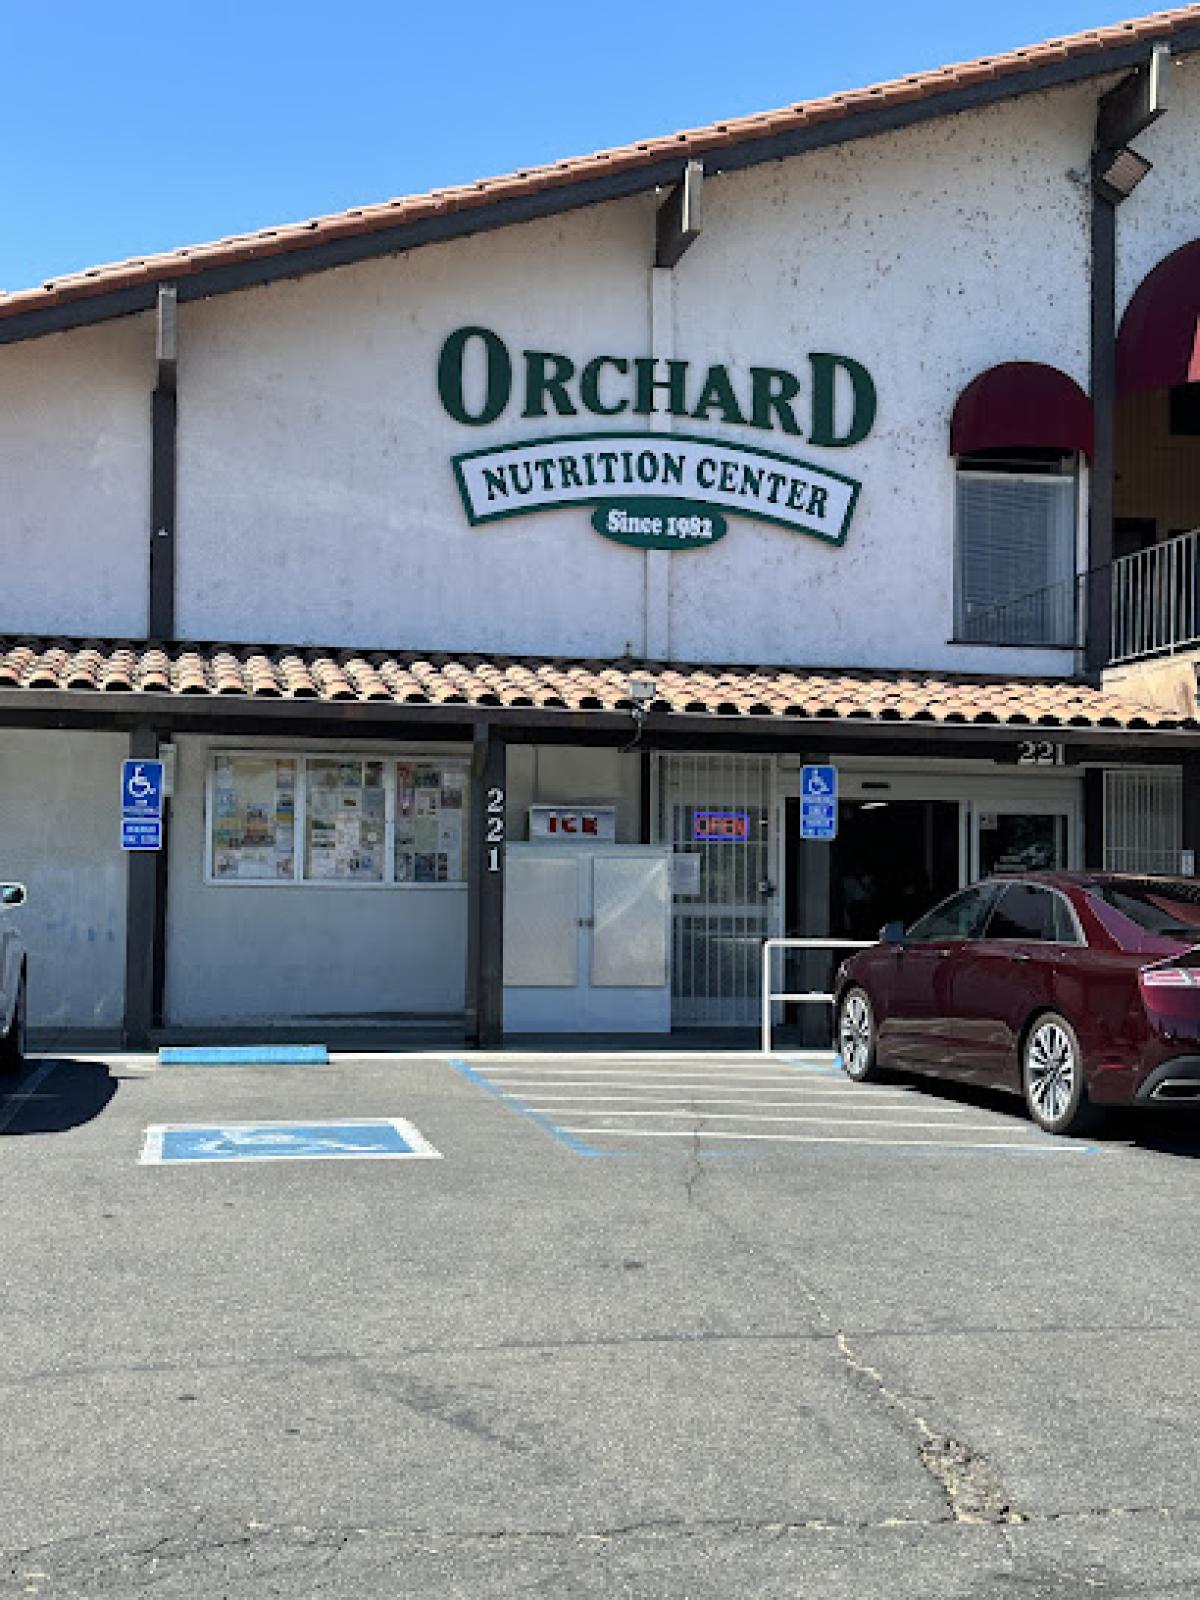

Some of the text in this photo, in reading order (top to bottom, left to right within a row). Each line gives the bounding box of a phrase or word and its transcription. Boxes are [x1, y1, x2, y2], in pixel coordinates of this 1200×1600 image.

[437, 326, 877, 447] ORCHARD
[482, 450, 828, 518] NUTRITION CENTER
[607, 509, 712, 539] Since 1982
[1018, 740, 1065, 765] 221
[696, 815, 746, 836] OPEN
